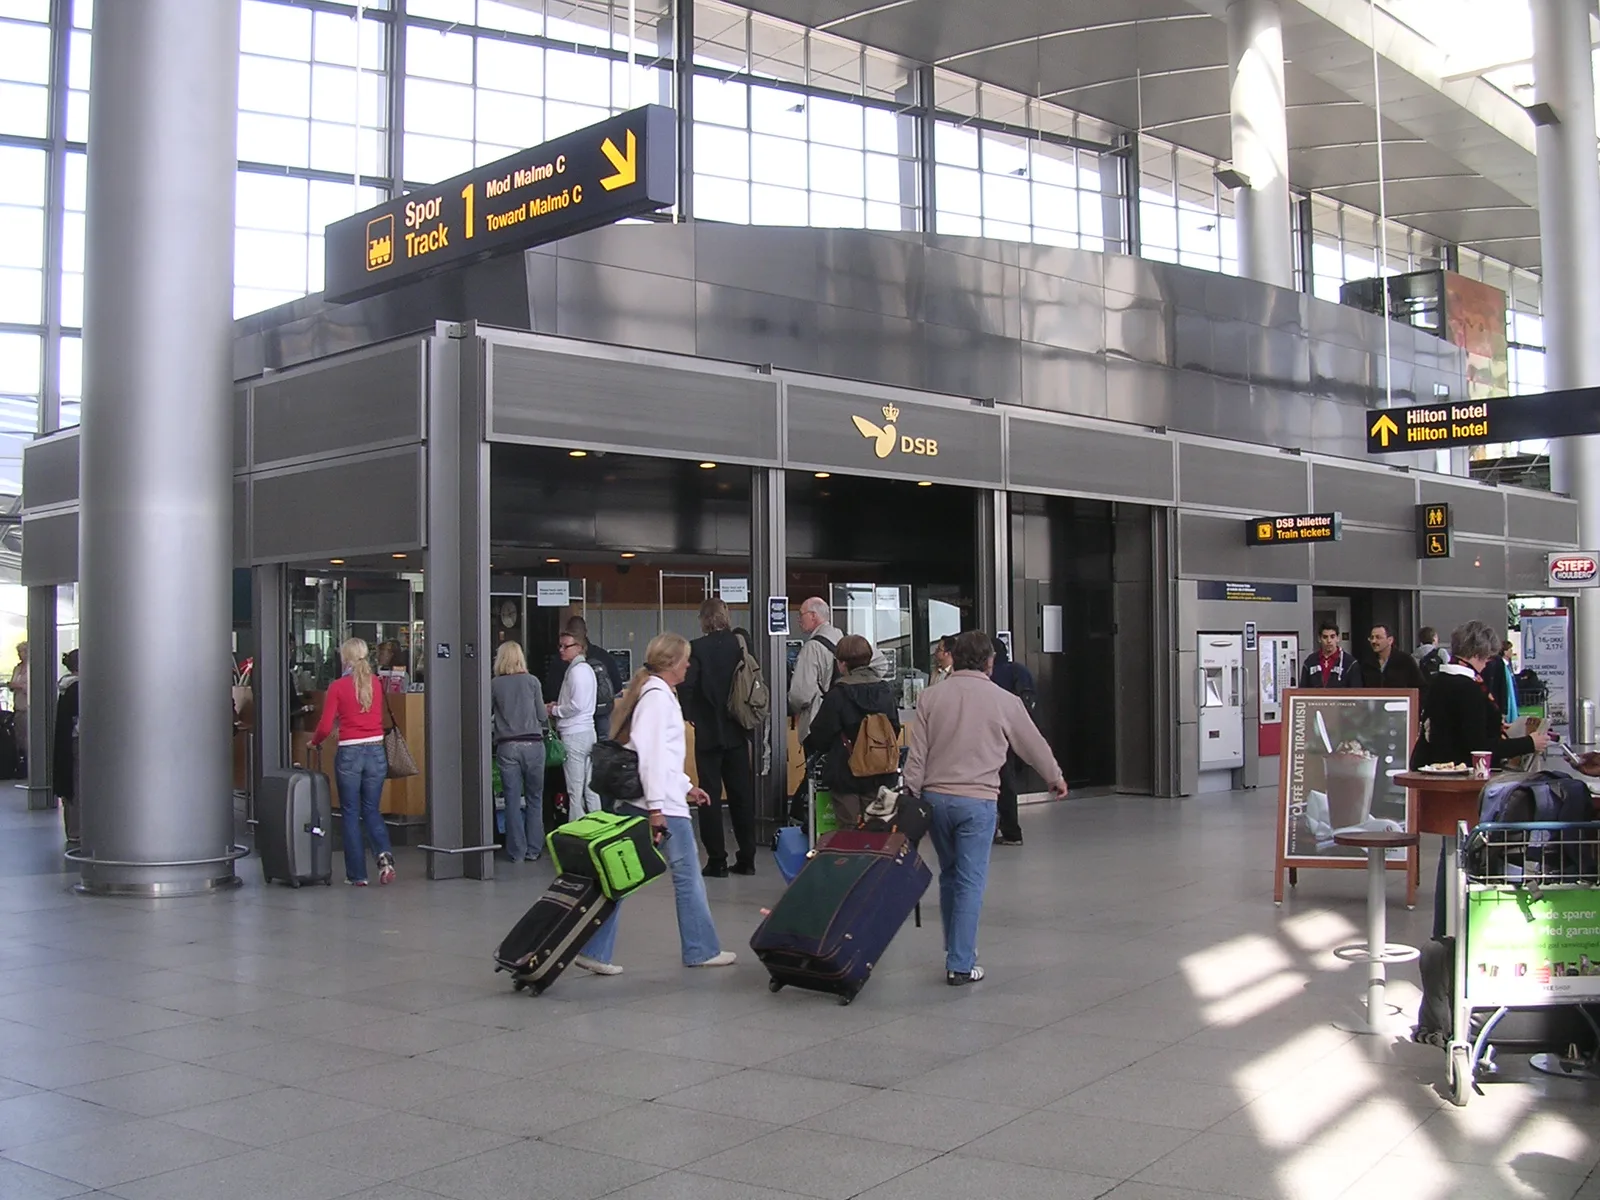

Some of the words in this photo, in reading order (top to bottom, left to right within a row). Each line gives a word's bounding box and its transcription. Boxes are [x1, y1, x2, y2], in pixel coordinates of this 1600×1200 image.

[486, 174, 511, 198] Mod
[514, 163, 553, 188] Malmø
[556, 154, 565, 174] C
[405, 196, 442, 229] Spor
[462, 183, 474, 239] 1
[486, 203, 526, 231] Toward
[530, 189, 569, 217] Malmö
[572, 184, 582, 203] C
[405, 222, 449, 258] Track
[1406, 409, 1447, 424] Hilton
[1451, 402, 1487, 420] hotel
[1407, 427, 1447, 442] Hilton
[1452, 420, 1488, 438] hotel
[901, 435, 938, 456] DSB
[1276, 518, 1294, 529] DSB
[1296, 516, 1331, 527] billetter
[1277, 529, 1299, 539] Train
[1300, 528, 1331, 537] tickets
[1556, 560, 1591, 571] STEFF
[1294, 702, 1307, 751] TIRAMISU
[1293, 753, 1305, 783] LATTE
[1562, 910, 1597, 921] sparer
